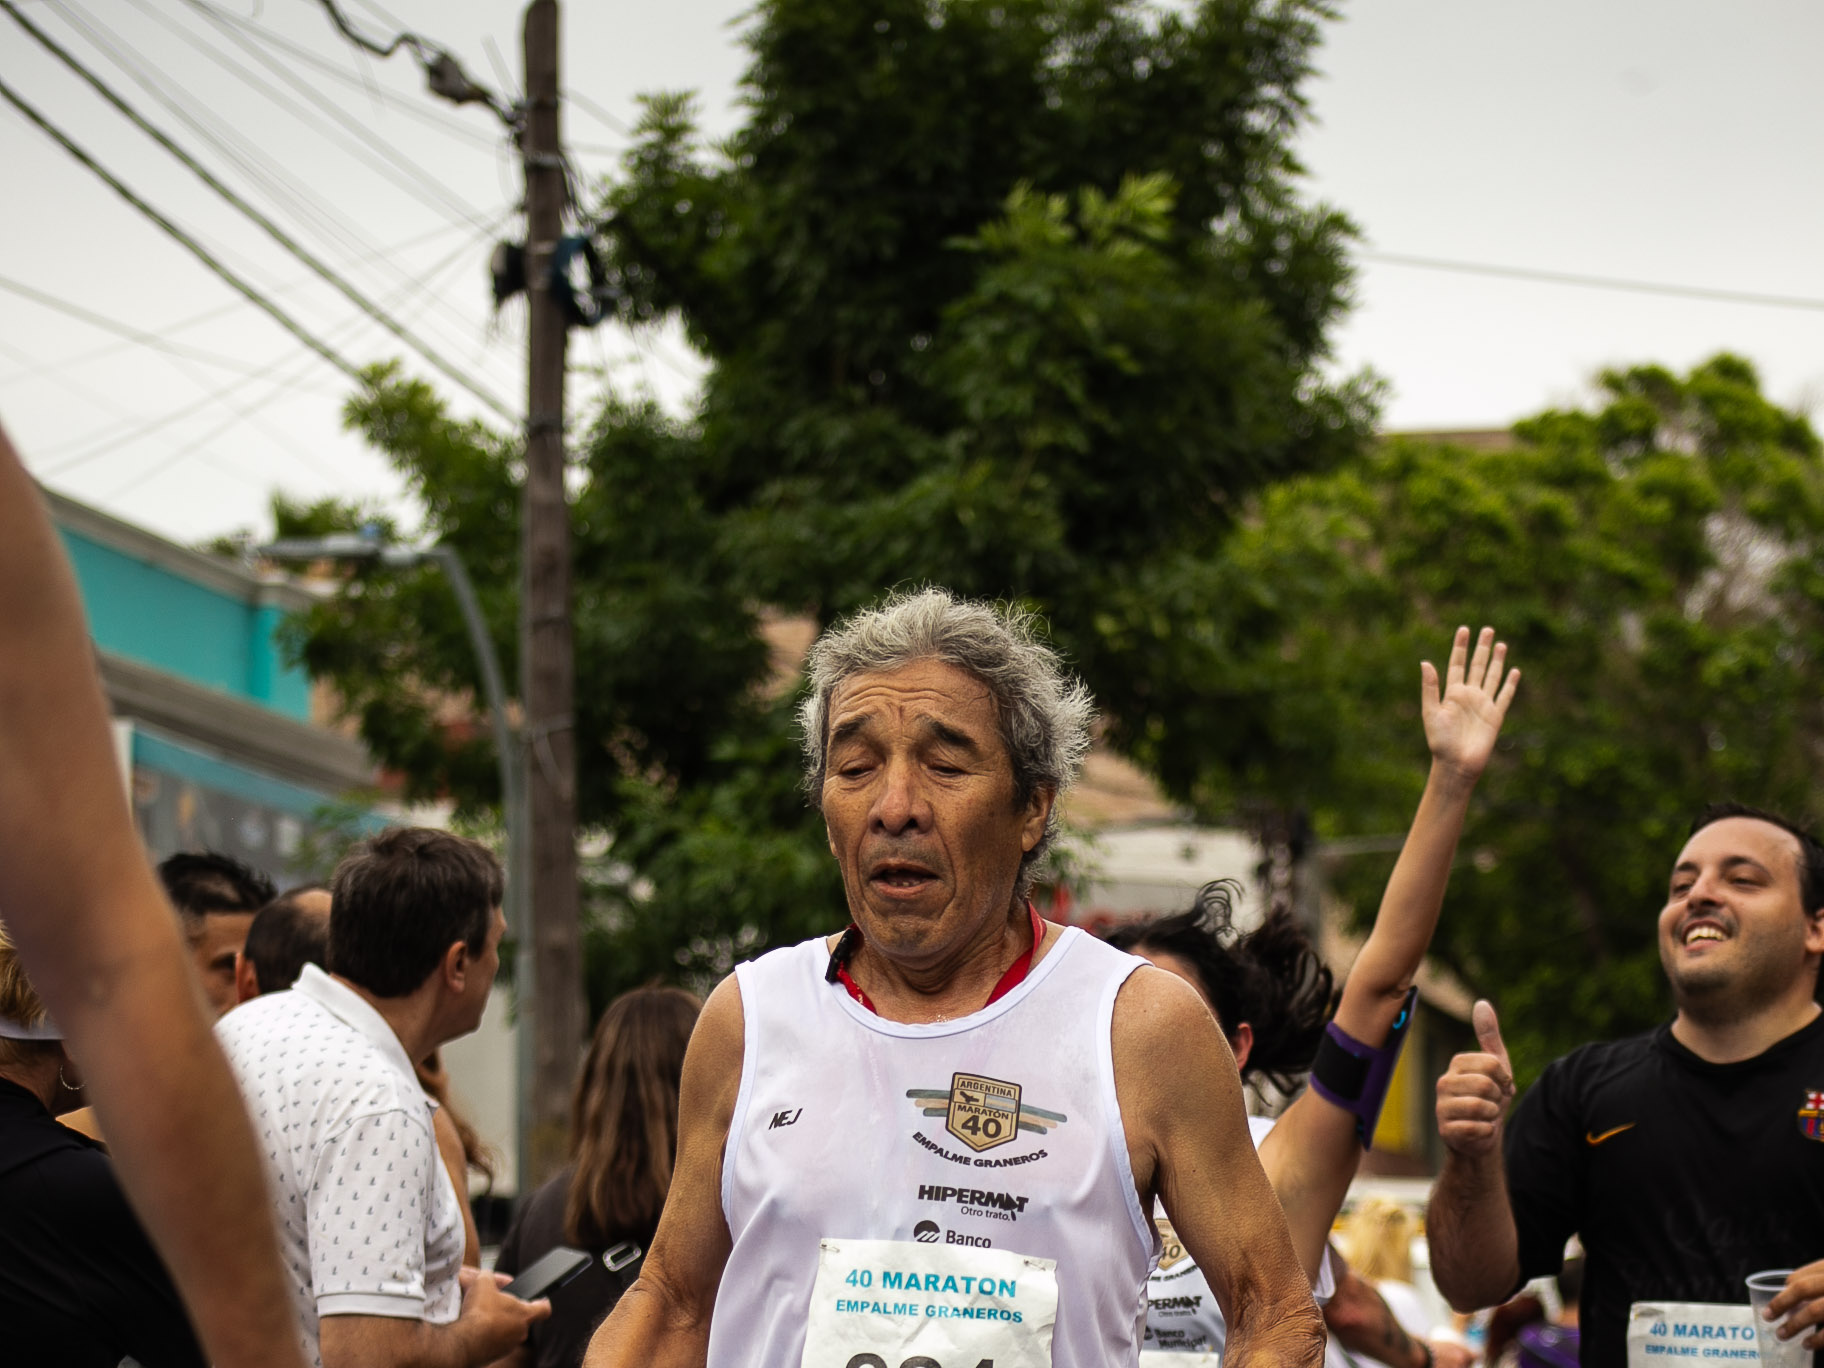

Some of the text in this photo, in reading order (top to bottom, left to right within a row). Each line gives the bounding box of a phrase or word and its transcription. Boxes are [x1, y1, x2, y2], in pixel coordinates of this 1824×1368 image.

[960, 1080, 1013, 1098] ARGENTINA
[768, 1108, 803, 1130] NEJ
[957, 1104, 1010, 1120] MARATÓN
[961, 1114, 1002, 1139] 40
[912, 1131, 1049, 1168] EMPALME GRANEROS
[960, 1205, 984, 1217] Otro
[945, 1229, 992, 1249] Banco
[845, 1268, 1017, 1298] 40 MARATON
[836, 1299, 1023, 1323] EMPALME GRANEROS
[1650, 1322, 1755, 1341] 40 MARATO
[1645, 1344, 1760, 1360] EMPALME GRANER
